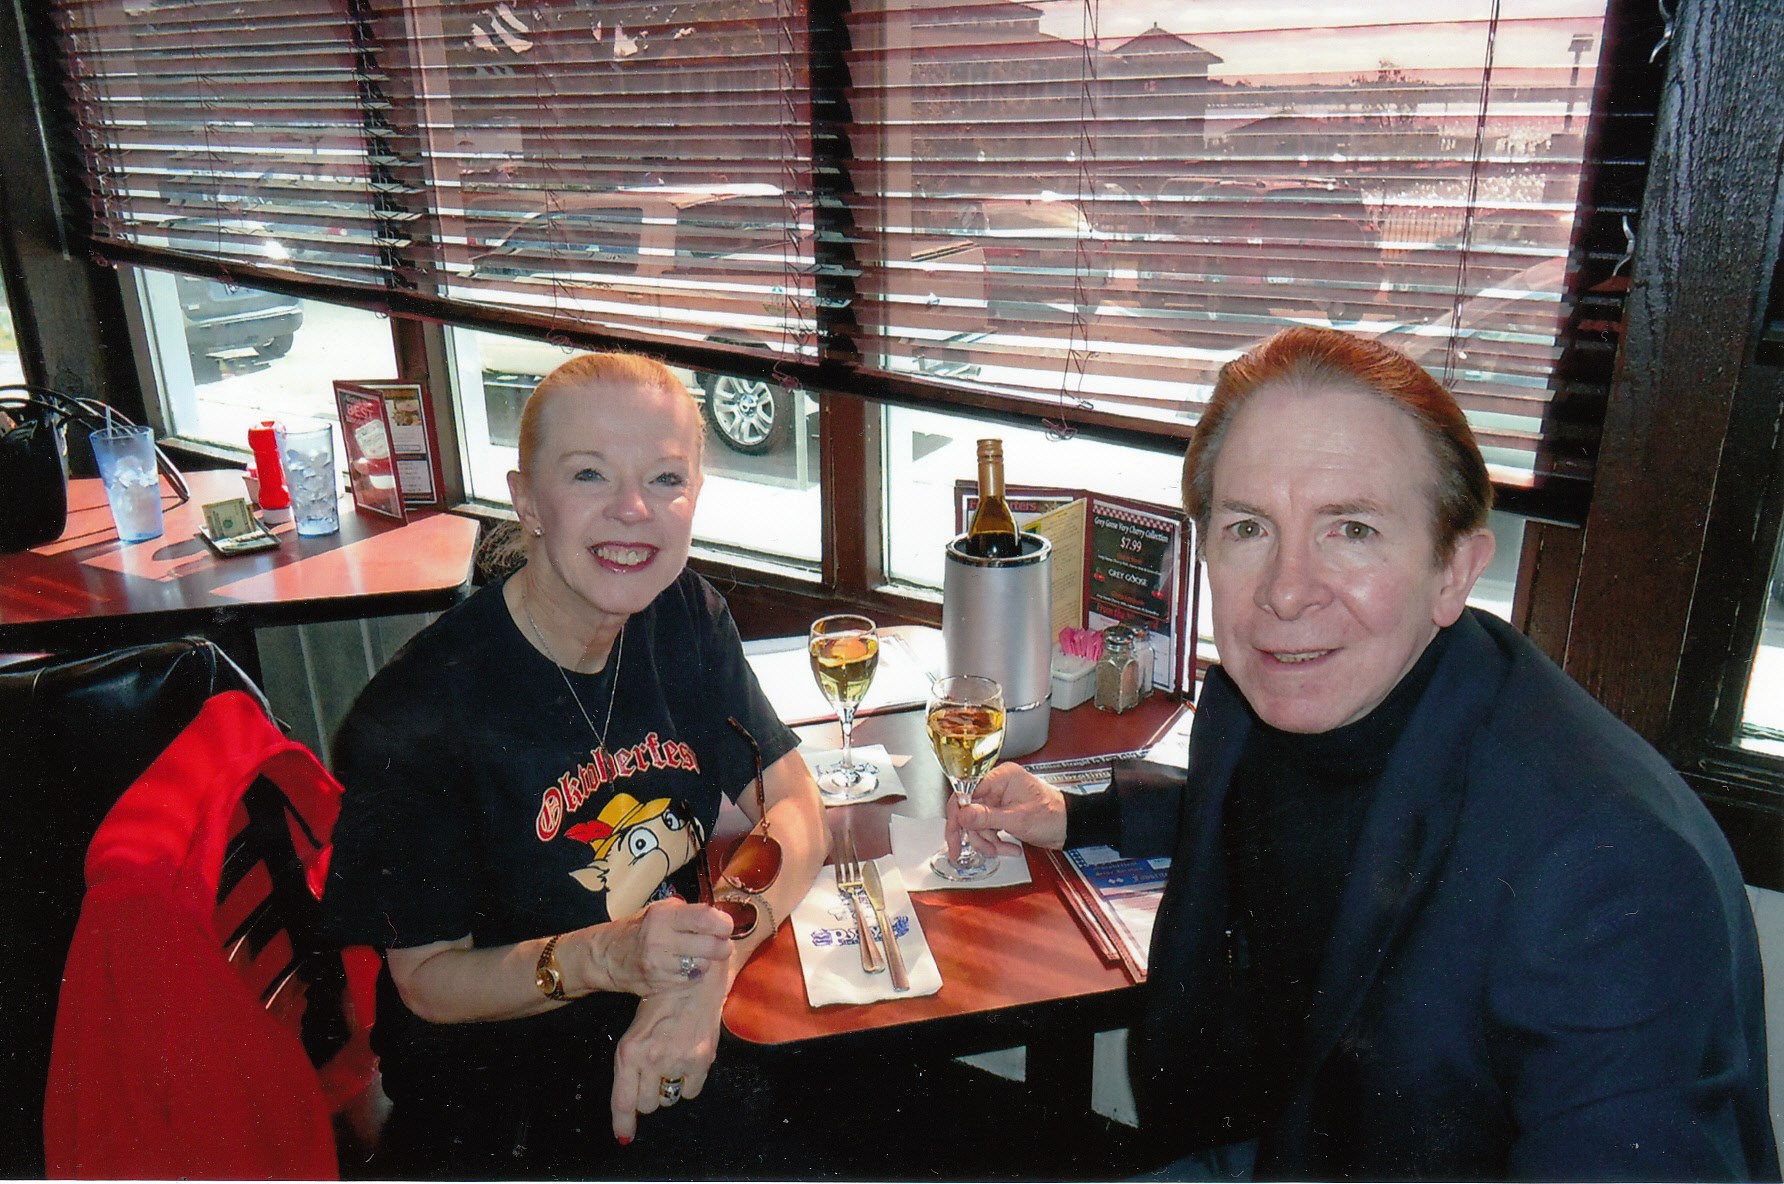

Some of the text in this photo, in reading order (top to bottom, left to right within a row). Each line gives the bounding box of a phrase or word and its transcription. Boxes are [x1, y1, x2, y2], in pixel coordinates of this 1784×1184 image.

[1094, 516, 1105, 528] Grey
[1105, 519, 1118, 529] Goose
[1129, 525, 1145, 539] Cherry
[1145, 529, 1169, 543] Collection
[1120, 536, 1142, 553] $7.99
[1108, 568, 1148, 587] GREY GOOSE
[535, 731, 701, 842] Oktoberfes
